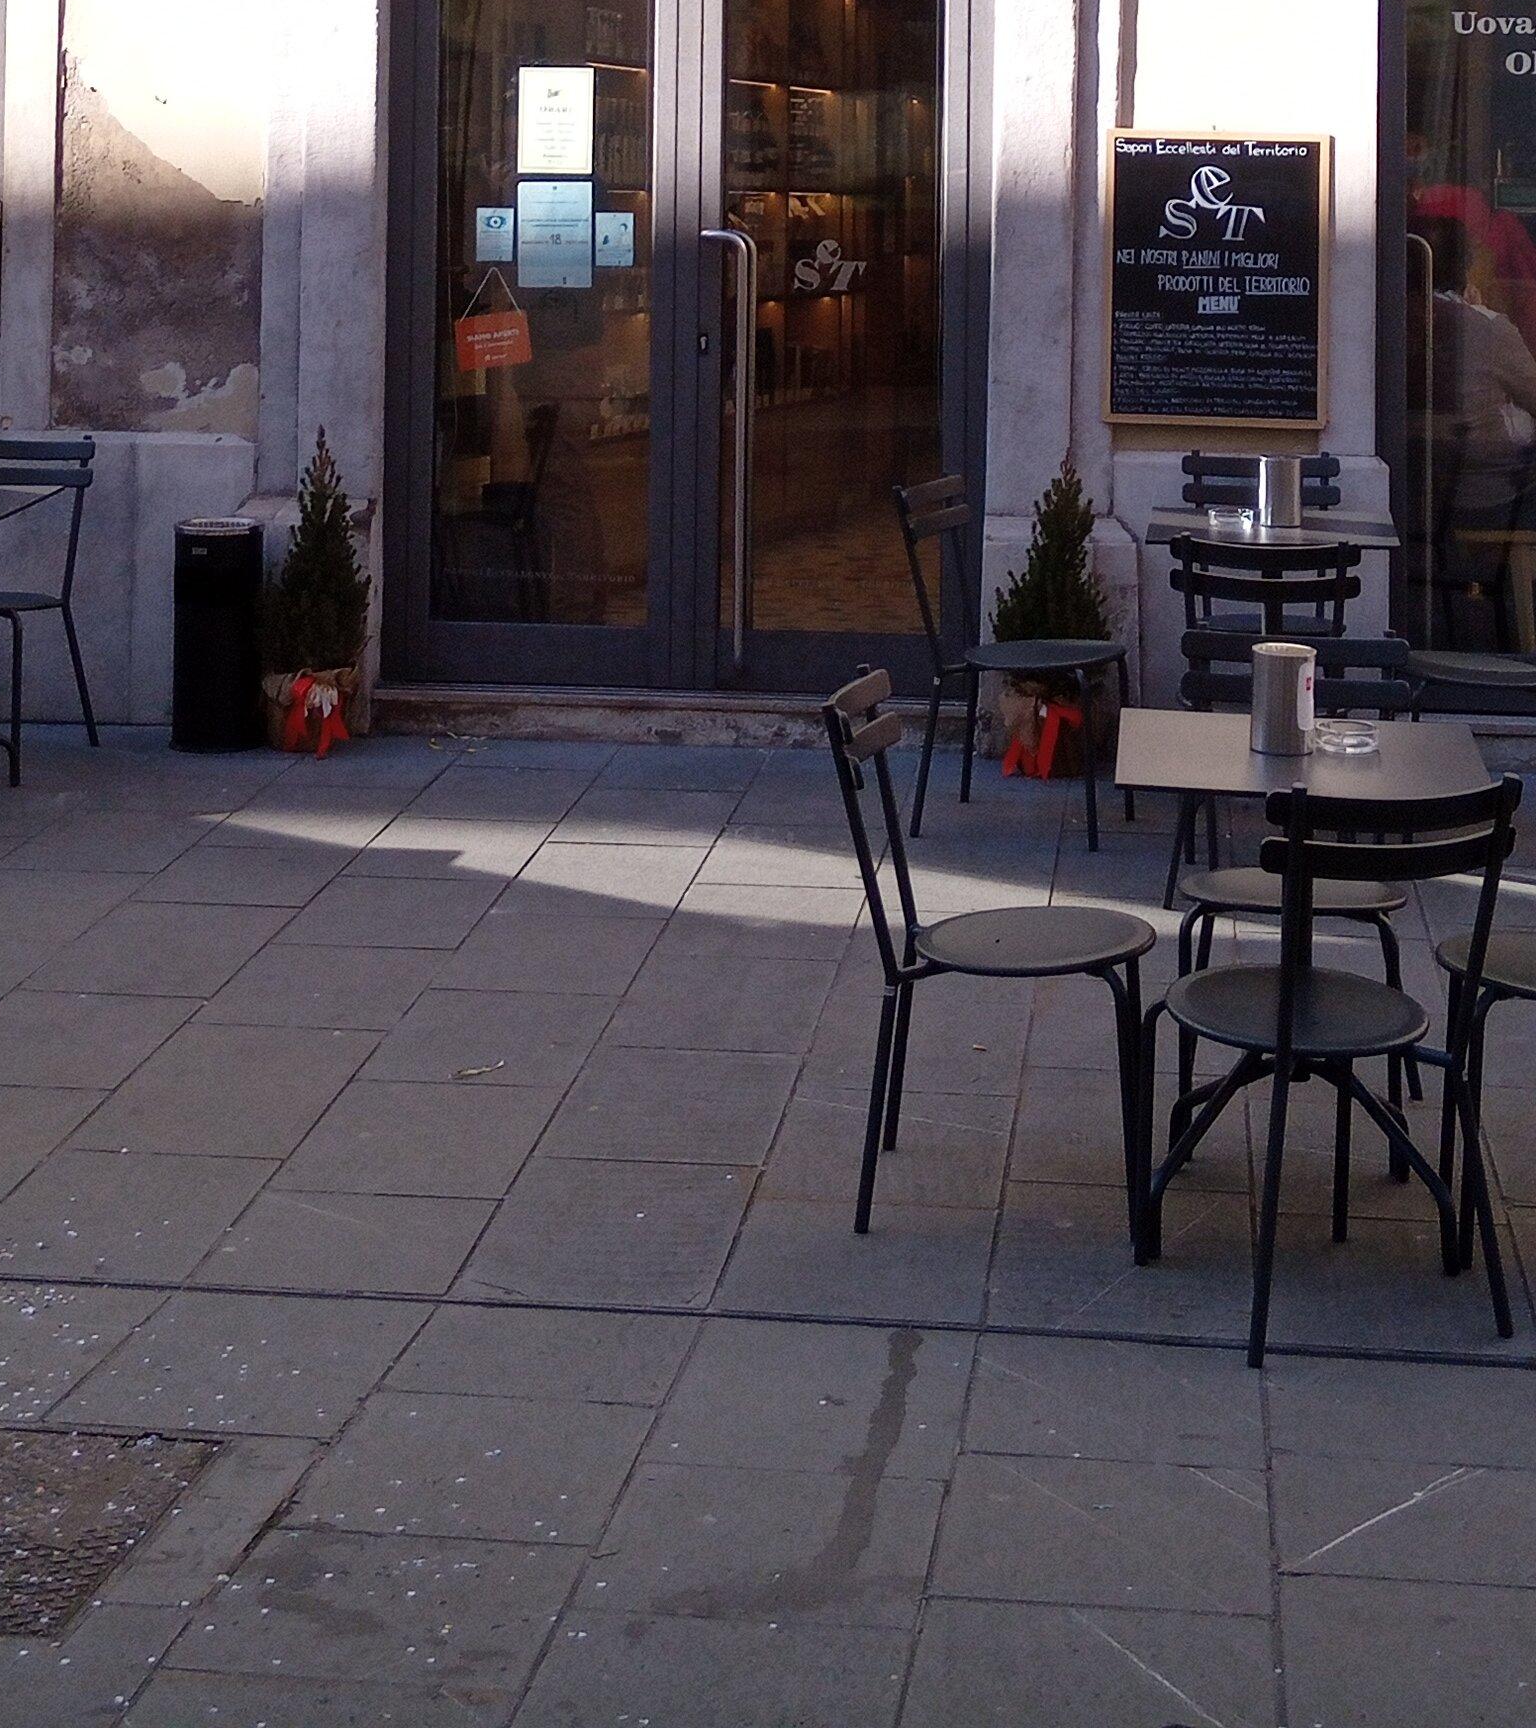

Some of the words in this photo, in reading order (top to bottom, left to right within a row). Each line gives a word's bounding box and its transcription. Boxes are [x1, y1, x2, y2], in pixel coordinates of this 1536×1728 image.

[1115, 138, 1152, 157] Sapori
[1222, 142, 1240, 156] del
[1244, 141, 1308, 157] Territorio
[1116, 248, 1135, 265] NEI
[1140, 248, 1178, 266] NOSTRI
[1182, 250, 1221, 269] PANINI
[1231, 252, 1280, 270] MIGLIORI
[1157, 274, 1213, 293] PRODOTTI
[1218, 276, 1241, 293] DEL
[1245, 275, 1310, 295] TERRITORIO
